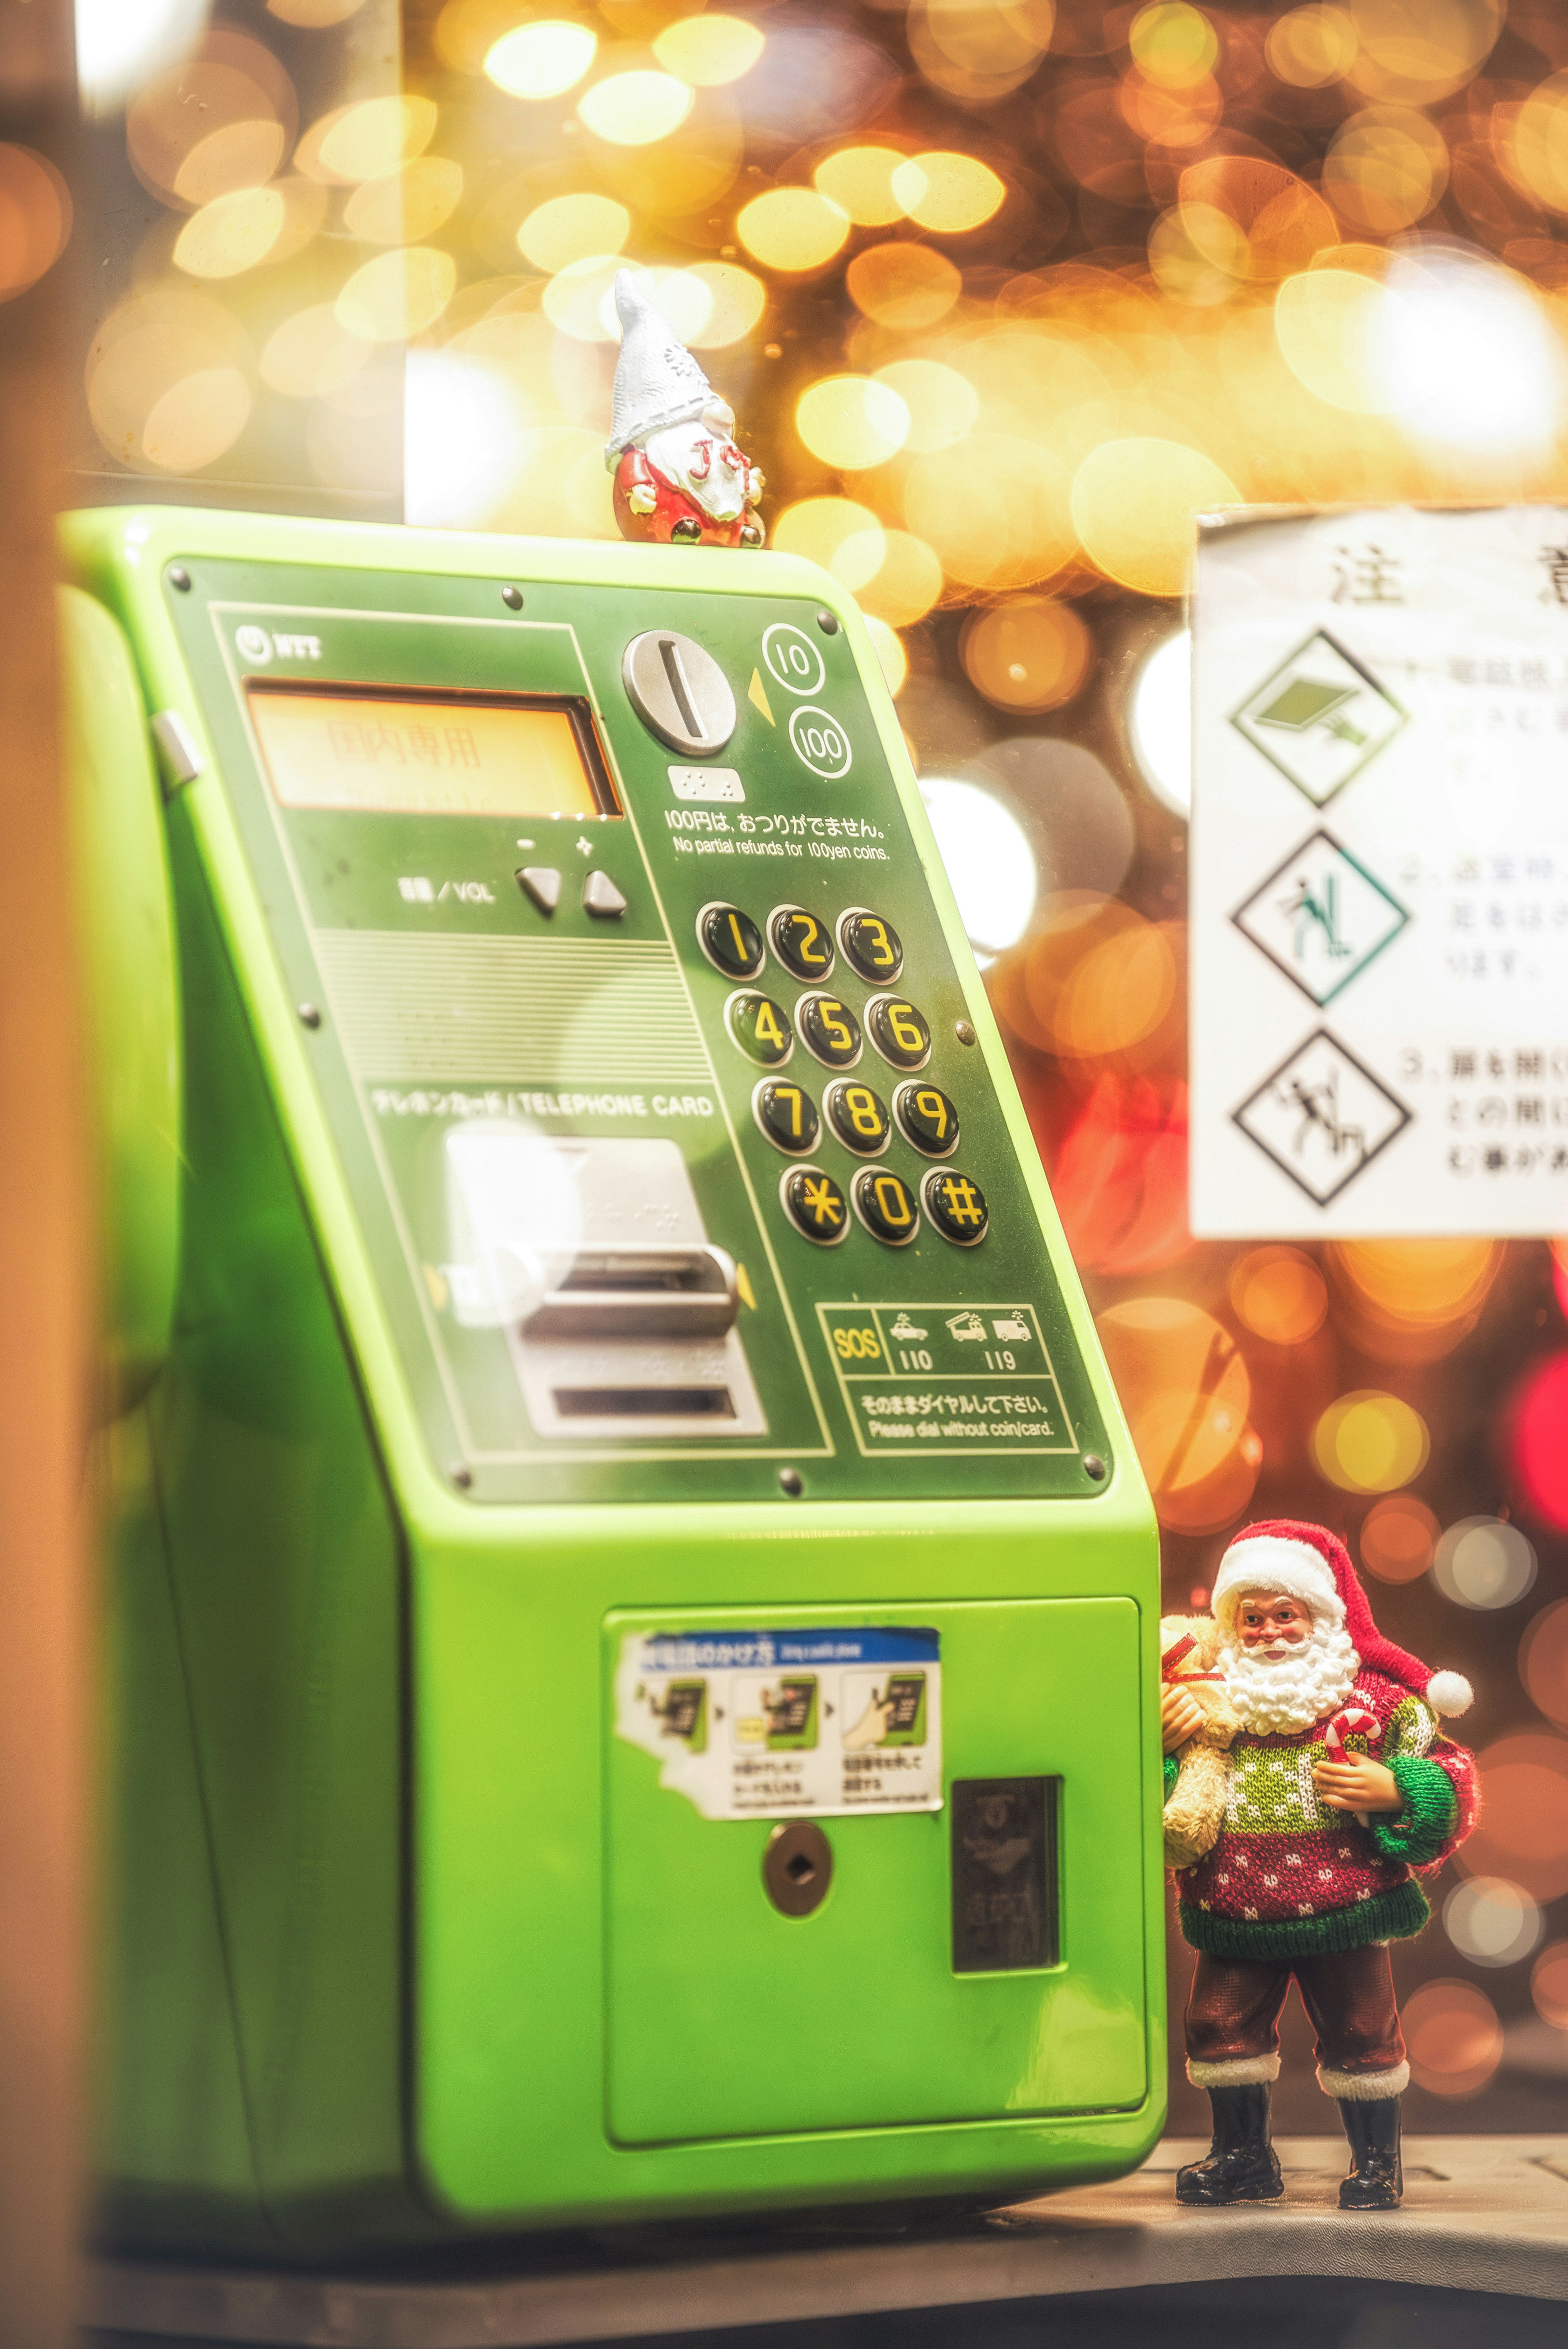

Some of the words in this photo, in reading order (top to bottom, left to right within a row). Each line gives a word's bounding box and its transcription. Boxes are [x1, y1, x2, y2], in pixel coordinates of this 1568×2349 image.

[775, 643, 810, 675] 10
[327, 719, 481, 768] 国内専用
[799, 727, 842, 759] 100
[673, 836, 693, 852] No
[695, 838, 734, 855] partial
[736, 839, 783, 855] refunds
[785, 841, 803, 857] for
[808, 842, 852, 860] 100yen
[853, 845, 891, 860] coins.
[728, 914, 747, 961] 1
[792, 915, 826, 962] 2
[861, 918, 894, 965] 3
[755, 1002, 783, 1049] 4
[819, 1002, 852, 1050] 5
[888, 1005, 923, 1051] 6
[517, 1092, 648, 1117] TELEPHONE
[652, 1094, 715, 1117] CARD
[775, 1088, 801, 1136] 7
[846, 1088, 882, 1135] 8
[916, 1091, 947, 1138] 9
[874, 1177, 911, 1226] 0
[834, 1328, 880, 1359] SOS
[900, 1350, 933, 1371] 110
[985, 1351, 1016, 1371] 119
[861, 1394, 1048, 1415] そのままダイヤルして下さい。
[868, 1420, 915, 1438] Please
[916, 1420, 940, 1437] dial
[941, 1420, 989, 1437] without
[990, 1420, 1054, 1437] coin/card.
